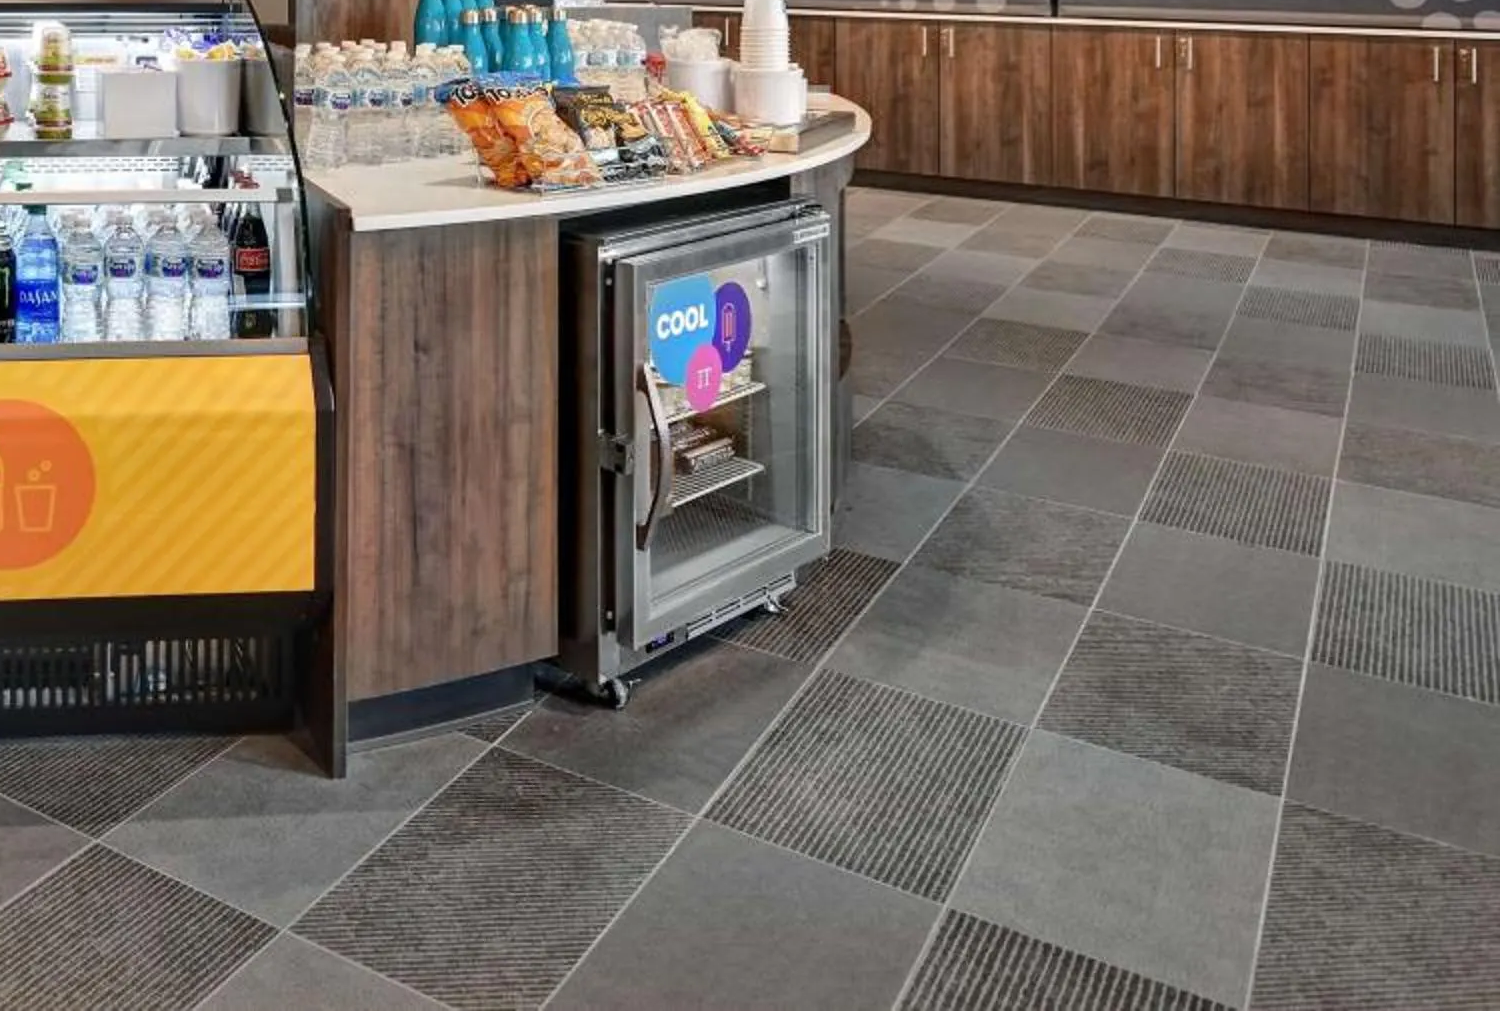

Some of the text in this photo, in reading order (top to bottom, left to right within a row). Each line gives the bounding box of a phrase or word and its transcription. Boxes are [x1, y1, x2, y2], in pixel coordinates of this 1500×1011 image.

[18, 290, 58, 308] DASAN
[656, 303, 709, 340] COOL
[695, 366, 713, 389] IT
